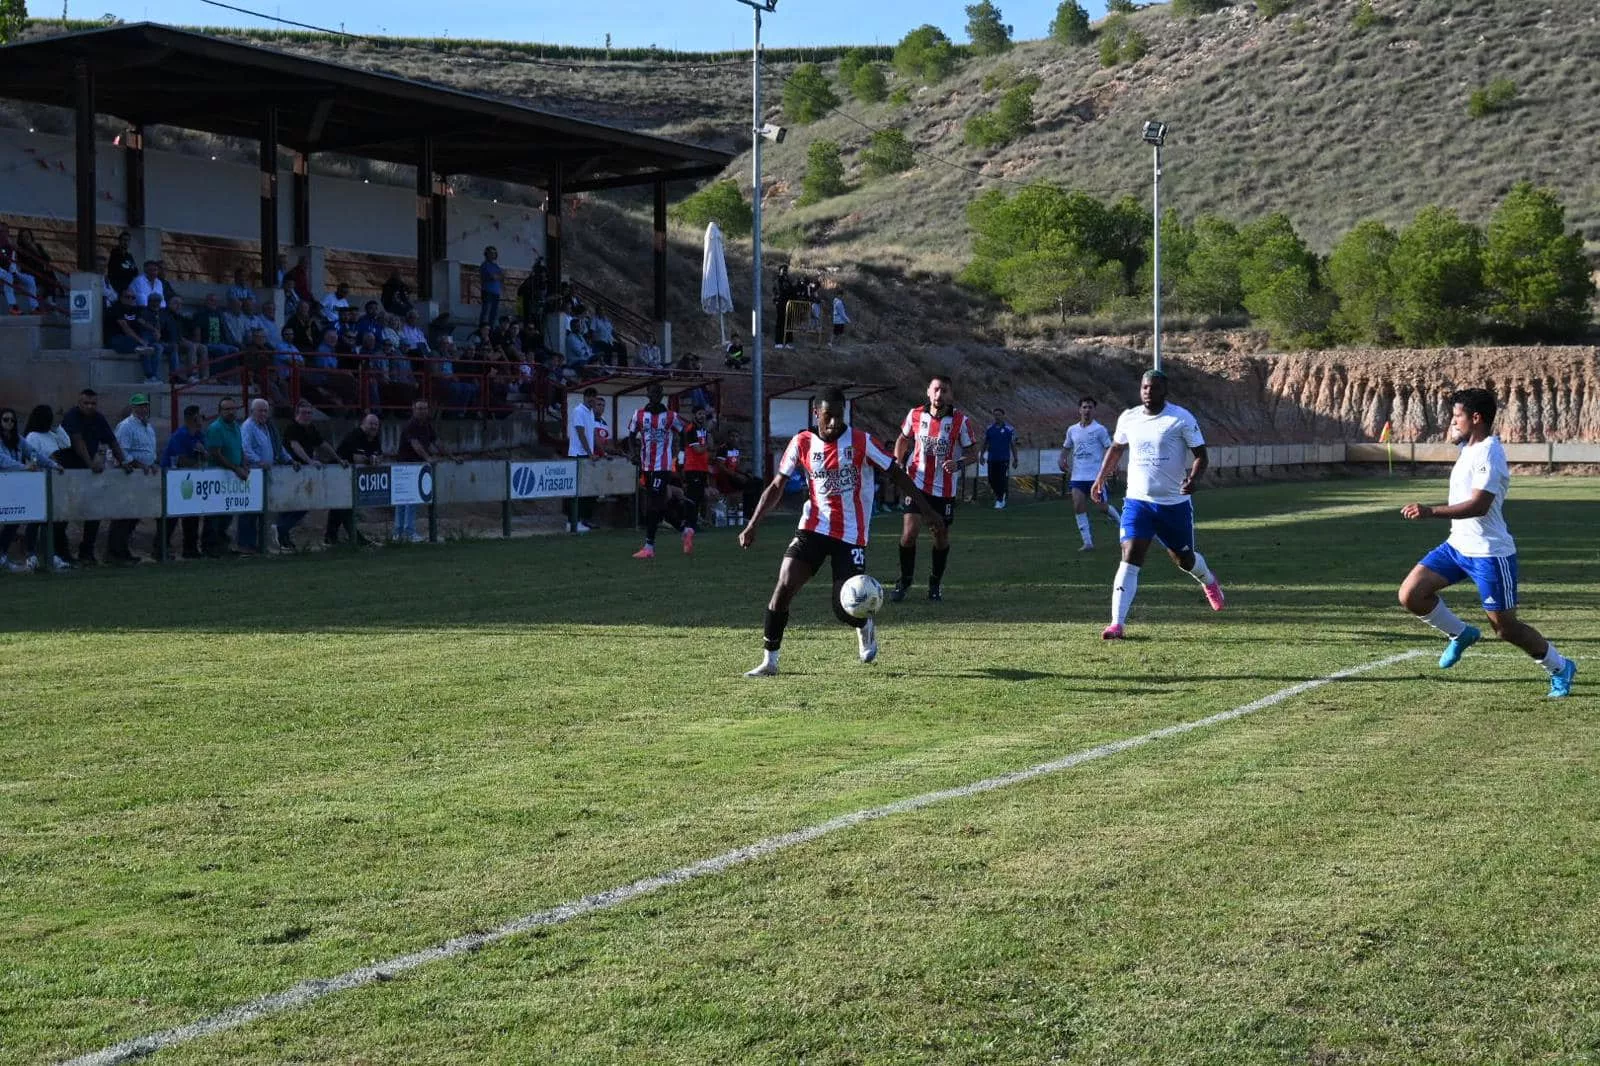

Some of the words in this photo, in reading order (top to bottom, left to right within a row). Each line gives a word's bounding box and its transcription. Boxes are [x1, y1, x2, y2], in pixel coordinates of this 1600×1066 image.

[813, 452, 822, 460] 75
[196, 479, 250, 500] agrostock
[533, 473, 574, 492] Arasanz
[225, 496, 250, 511] group
